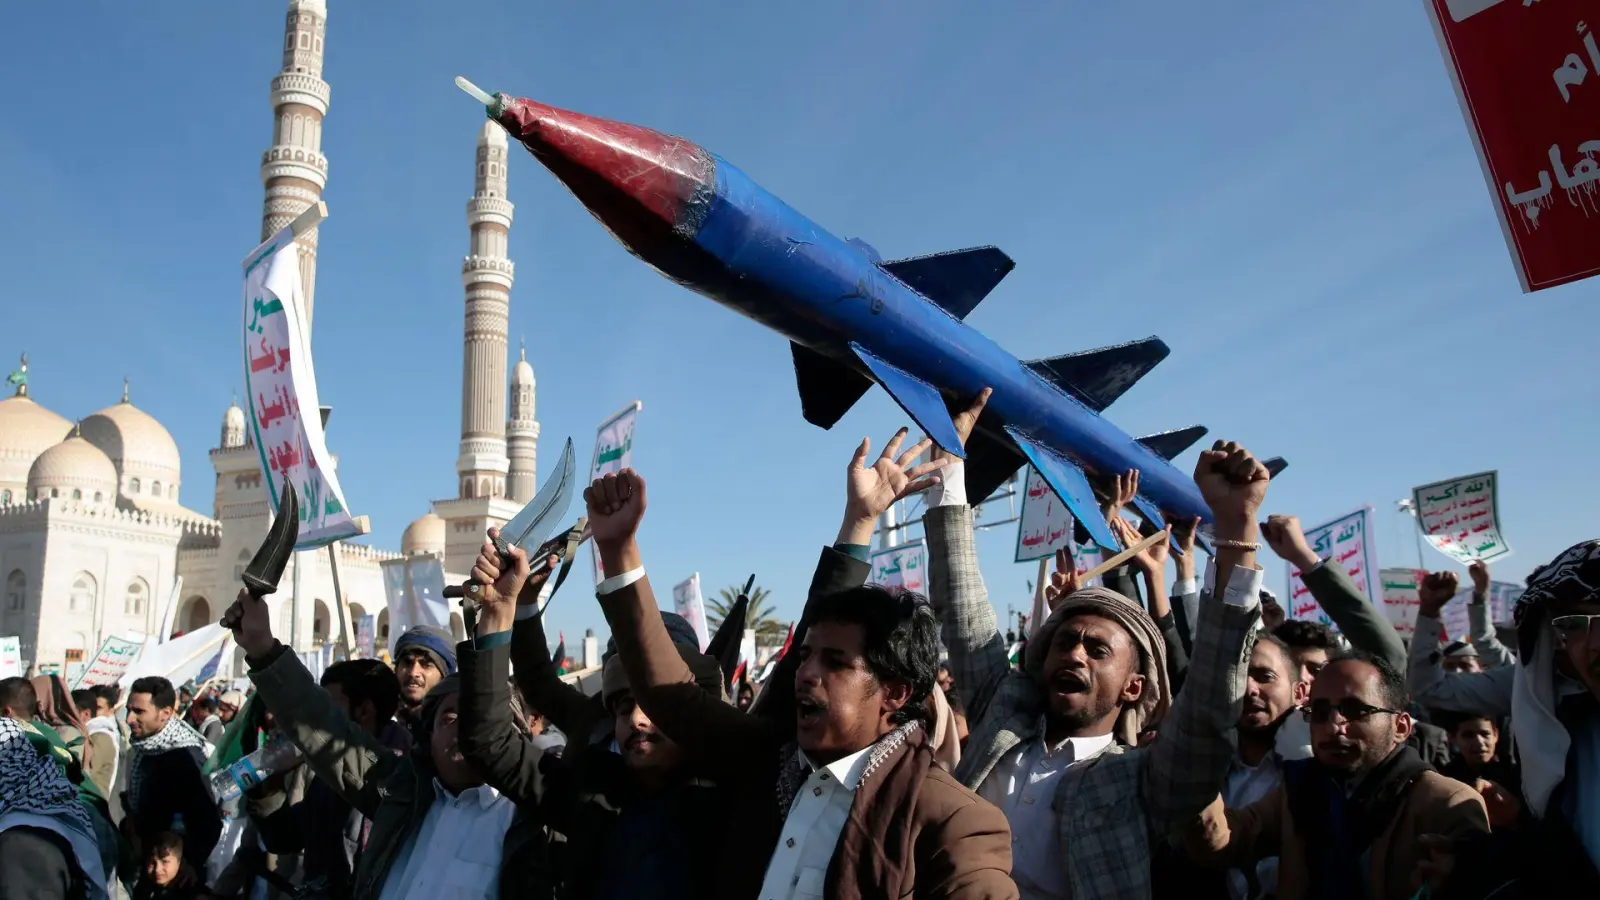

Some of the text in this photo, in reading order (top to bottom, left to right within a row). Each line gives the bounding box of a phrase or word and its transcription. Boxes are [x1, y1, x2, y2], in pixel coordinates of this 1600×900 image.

[1505, 139, 1600, 228] هاب
[248, 296, 284, 335] بر
[1464, 478, 1491, 493] الله
[1336, 520, 1361, 543] الله
